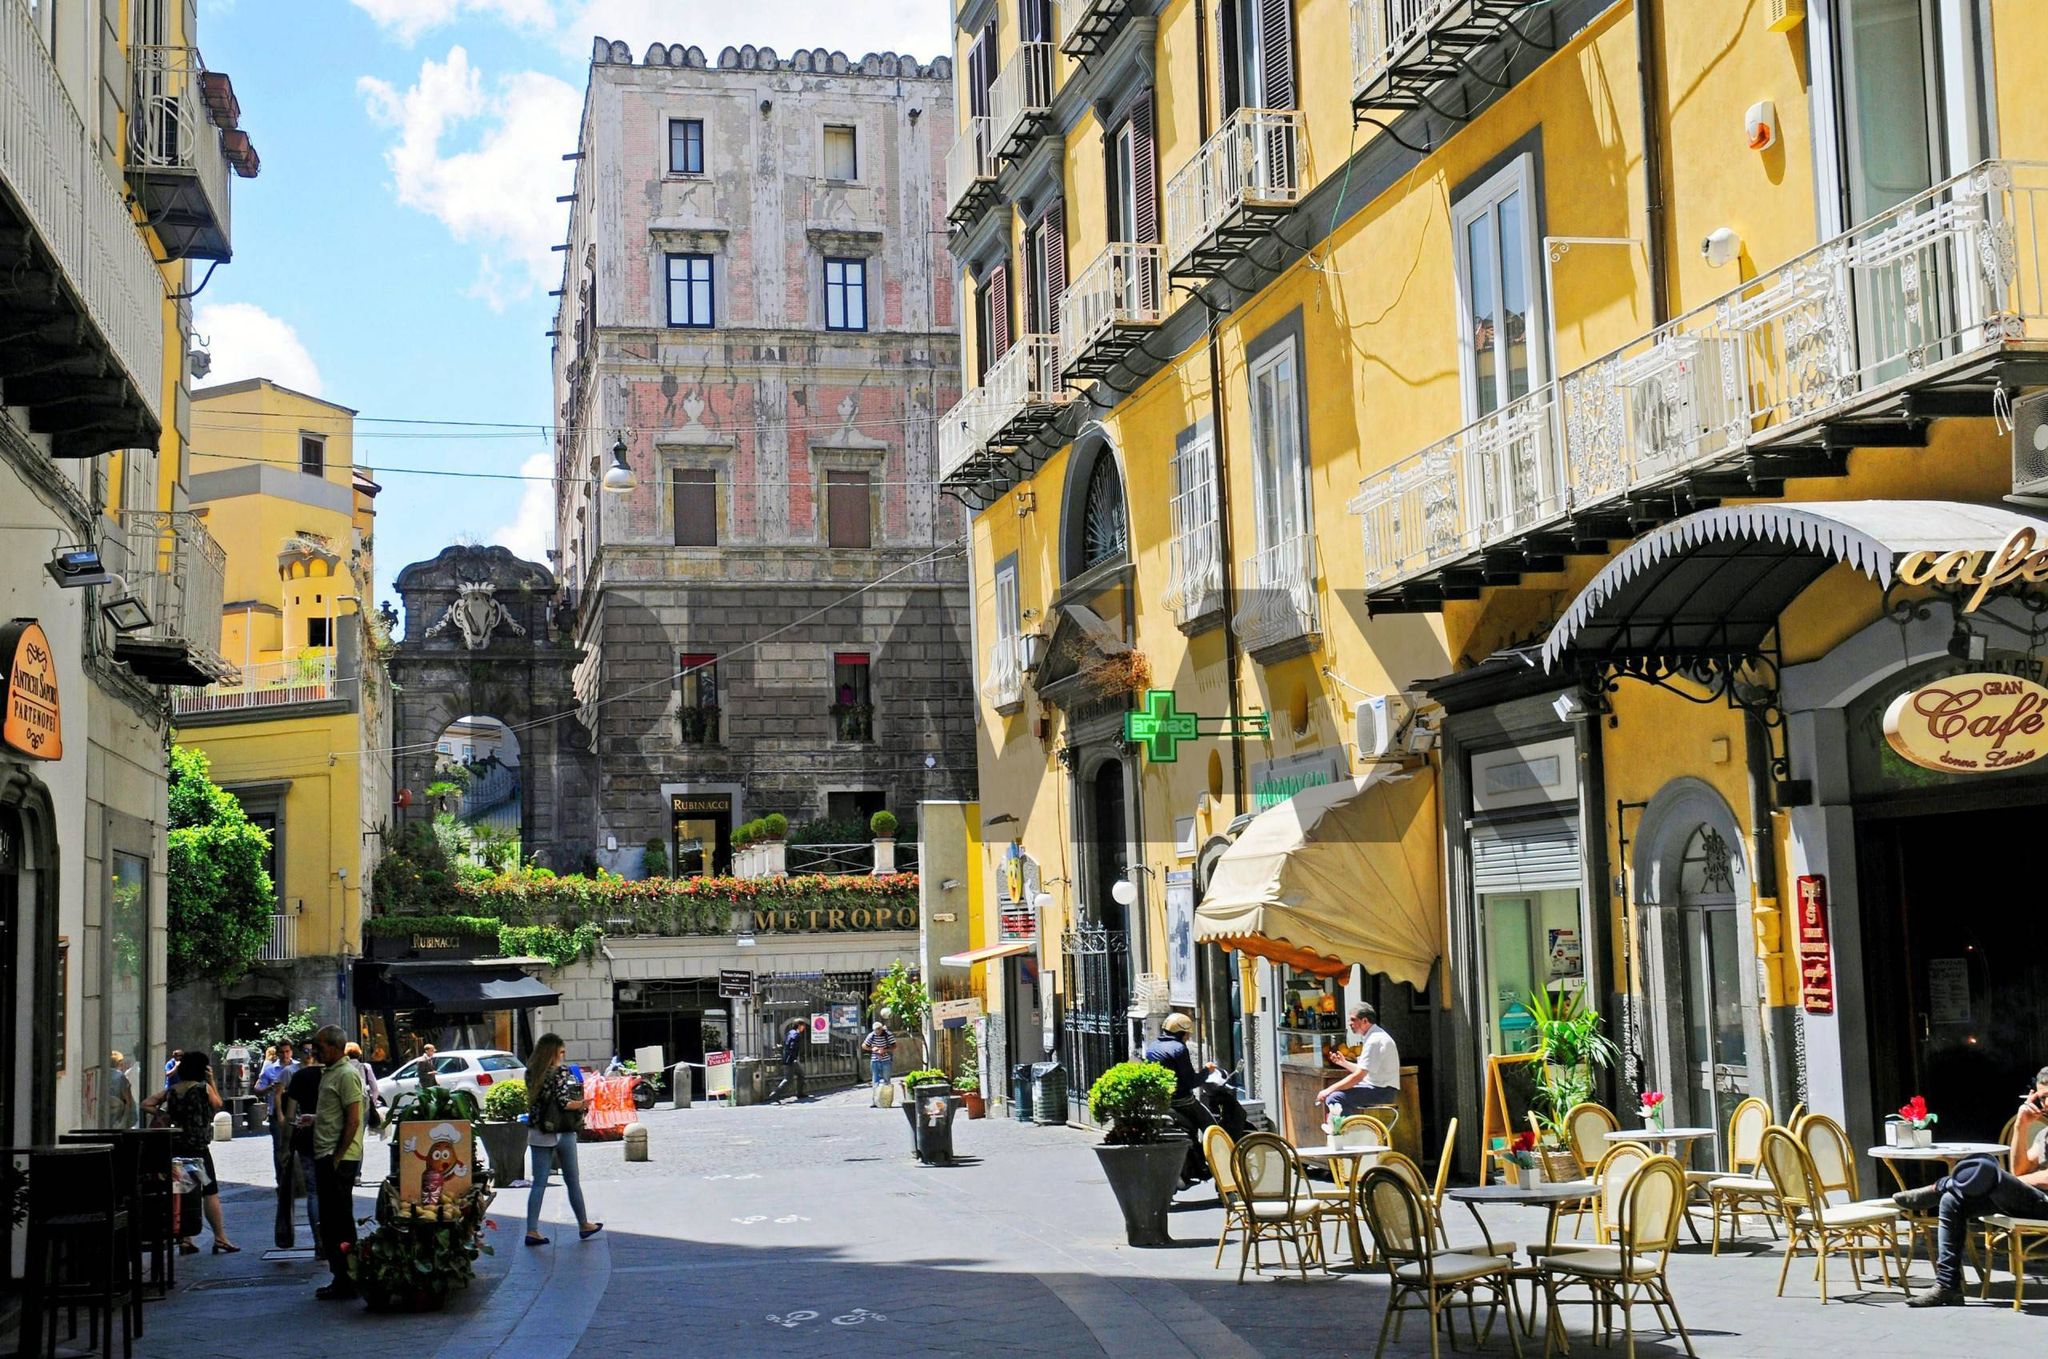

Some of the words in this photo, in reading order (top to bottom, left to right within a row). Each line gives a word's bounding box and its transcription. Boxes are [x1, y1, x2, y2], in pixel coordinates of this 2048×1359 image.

[13, 660, 39, 696] ANTICHI
[1983, 681, 2023, 695] GRAN
[14, 700, 56, 733] PARTENOPEI
[1913, 688, 2048, 749] Café
[1939, 750, 1978, 768] donna
[1984, 748, 2036, 768] Luisa
[673, 799, 729, 810] RUBINACCI
